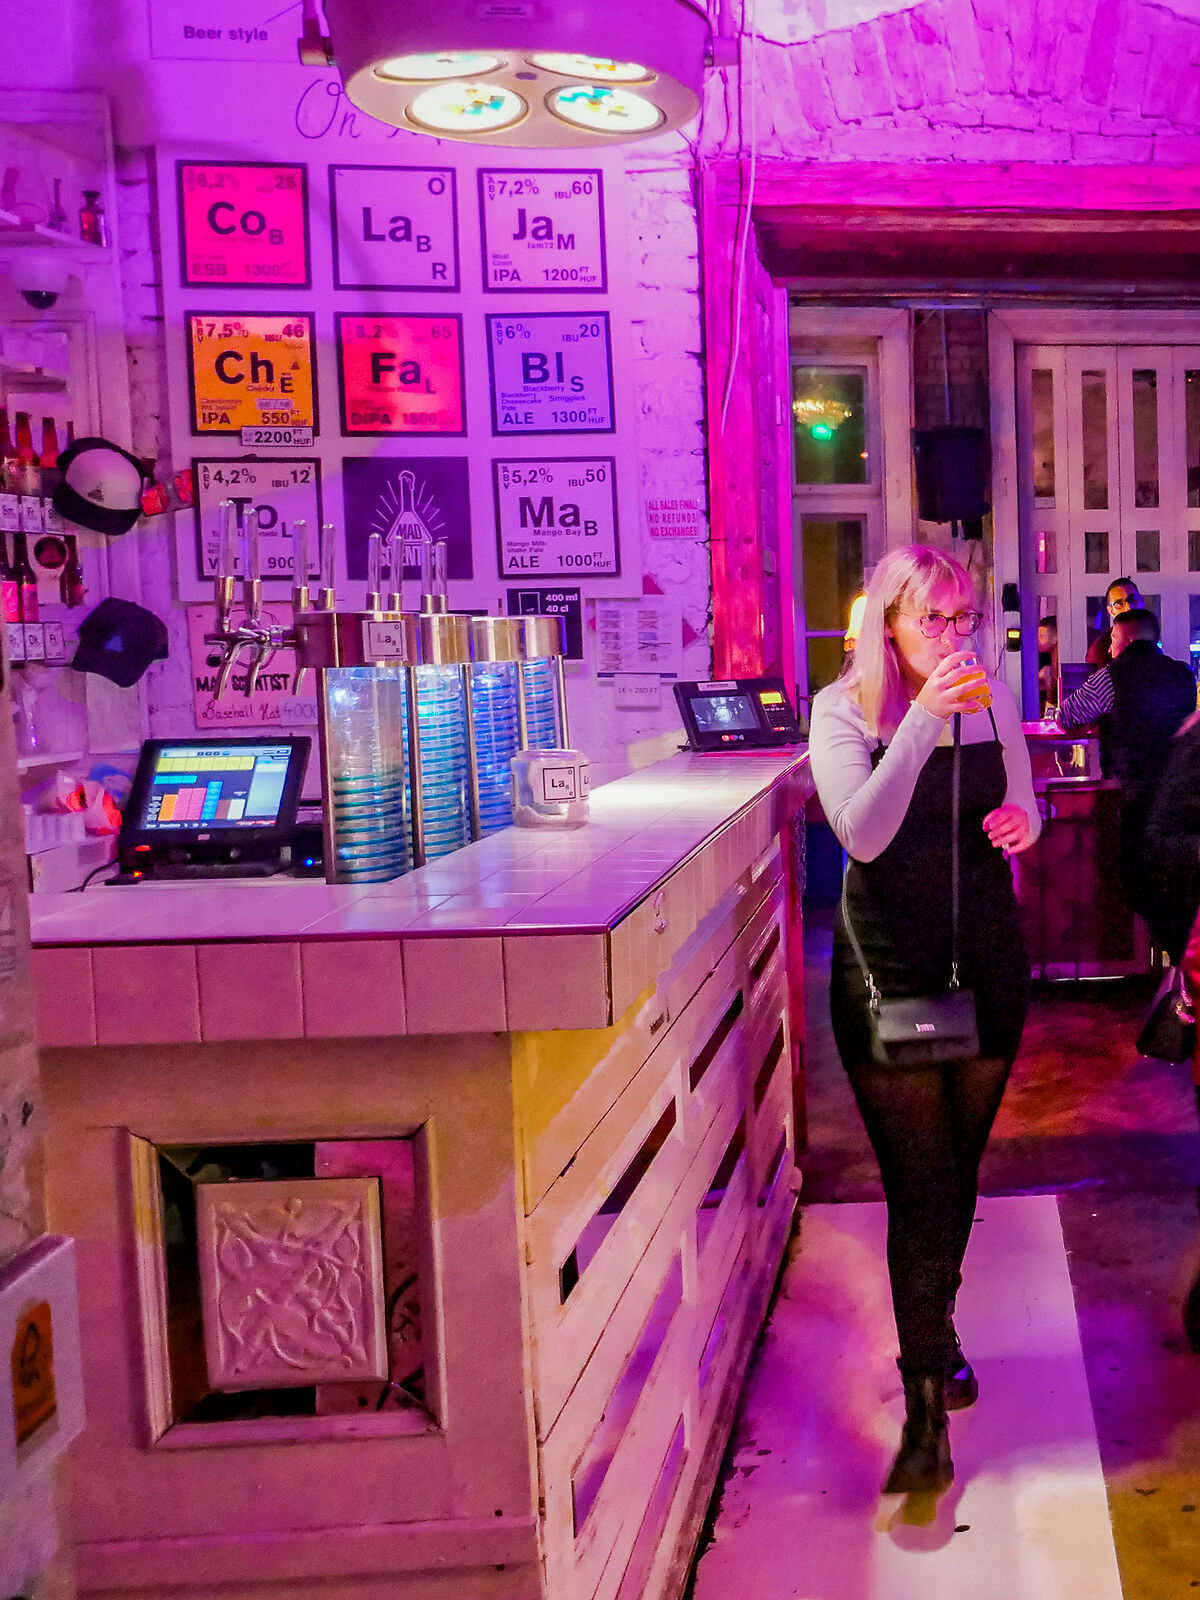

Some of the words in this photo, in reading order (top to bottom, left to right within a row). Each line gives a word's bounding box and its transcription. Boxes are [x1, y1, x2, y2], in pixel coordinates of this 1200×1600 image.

[184, 26, 222, 40] Beer
[229, 27, 269, 43] style
[275, 174, 297, 190] 25
[497, 179, 540, 198] 7,2%
[554, 191, 572, 199] IBU
[572, 180, 593, 195] 60
[192, 263, 228, 276] ESB
[431, 262, 448, 280] R
[493, 269, 522, 282] IPA
[542, 268, 578, 281] 1200
[204, 321, 249, 339] 7,5%
[282, 323, 305, 338] 46
[431, 325, 452, 339] 65
[505, 323, 531, 339] 6%
[562, 334, 579, 342] IBU
[579, 323, 600, 338] 20
[523, 385, 565, 393] Blackberry
[201, 412, 231, 425] IPA
[261, 411, 289, 425] 550
[503, 411, 535, 425] ALE
[551, 410, 587, 423] 1300
[254, 431, 292, 443] 2200
[213, 468, 257, 487] 4,2%
[271, 480, 289, 488] IBU
[290, 469, 310, 484] 12
[511, 467, 554, 487] 5,2%
[568, 479, 585, 487] IBU
[585, 468, 606, 483] 50
[660, 500, 679, 511] SALES
[649, 513, 659, 524] NO
[395, 523, 423, 540] MAD
[533, 529, 562, 537] Mango
[650, 526, 660, 537] NO
[508, 555, 540, 569] ALE
[557, 554, 592, 567] 1000
[545, 593, 564, 602] 400
[565, 593, 578, 601] ml
[546, 605, 559, 613] 40
[560, 604, 569, 613] cl
[232, 673, 291, 691] SCNTIST
